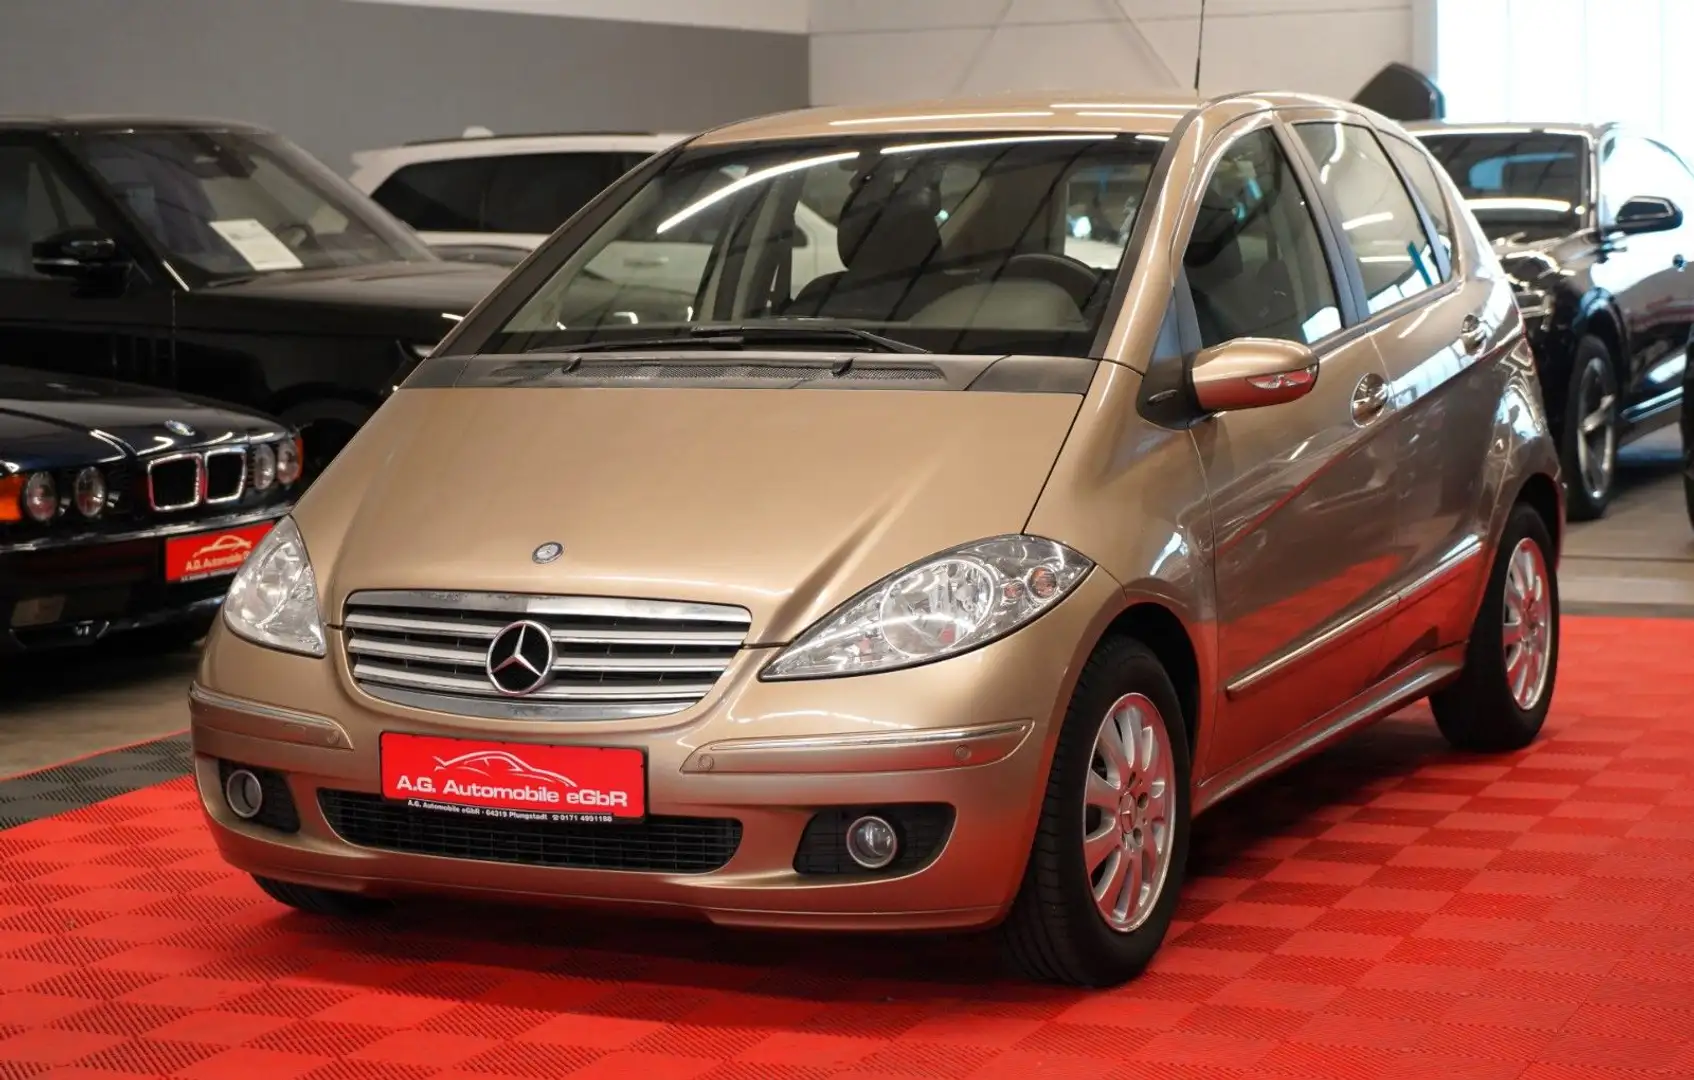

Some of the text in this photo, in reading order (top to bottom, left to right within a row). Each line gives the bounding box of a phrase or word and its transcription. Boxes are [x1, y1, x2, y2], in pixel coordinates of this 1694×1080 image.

[396, 775, 628, 807] A.G. Automobile eGbR
[407, 799, 421, 808] A.G.
[423, 802, 460, 813] Automobile
[461, 807, 480, 815] eGbR
